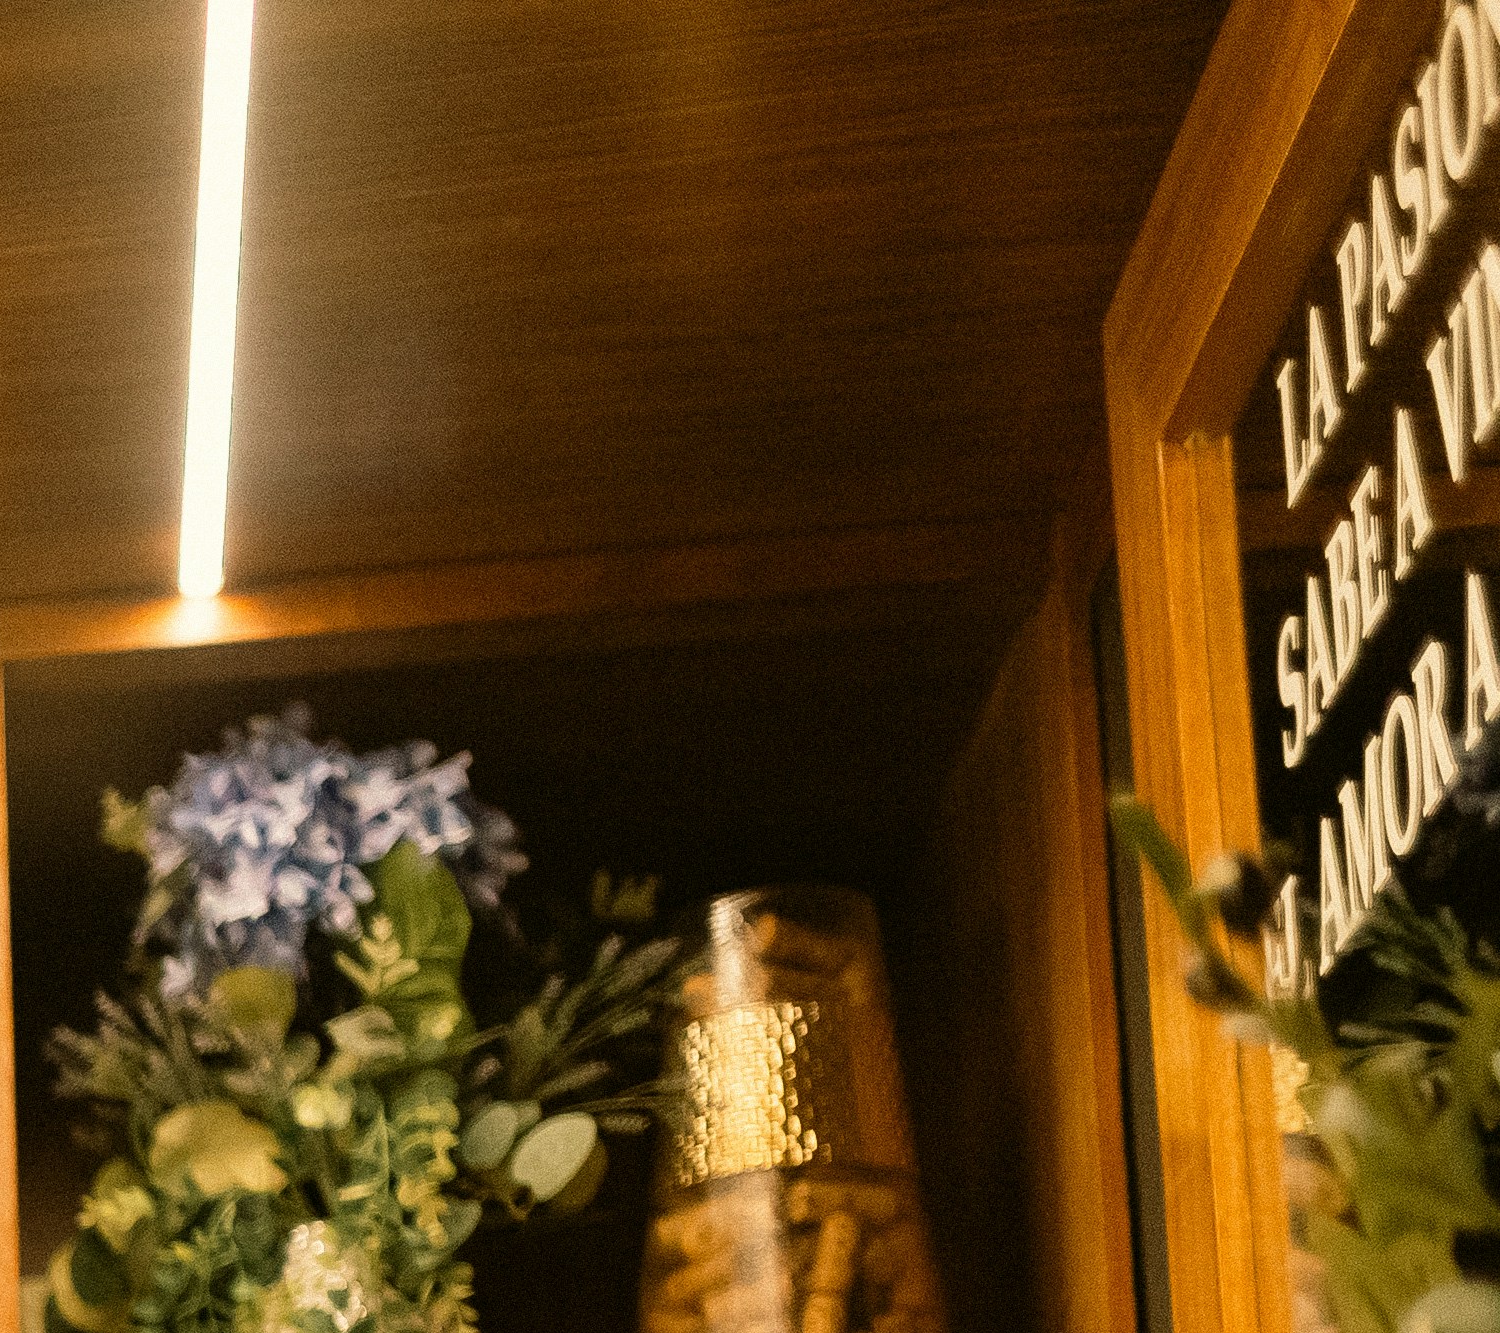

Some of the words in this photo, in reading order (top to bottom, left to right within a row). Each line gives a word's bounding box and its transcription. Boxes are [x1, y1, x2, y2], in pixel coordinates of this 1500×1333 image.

[1276, 304, 1343, 509] LA
[1277, 464, 1390, 769] SABE
[1395, 406, 1434, 580] A
[1319, 641, 1459, 977] AMOR
